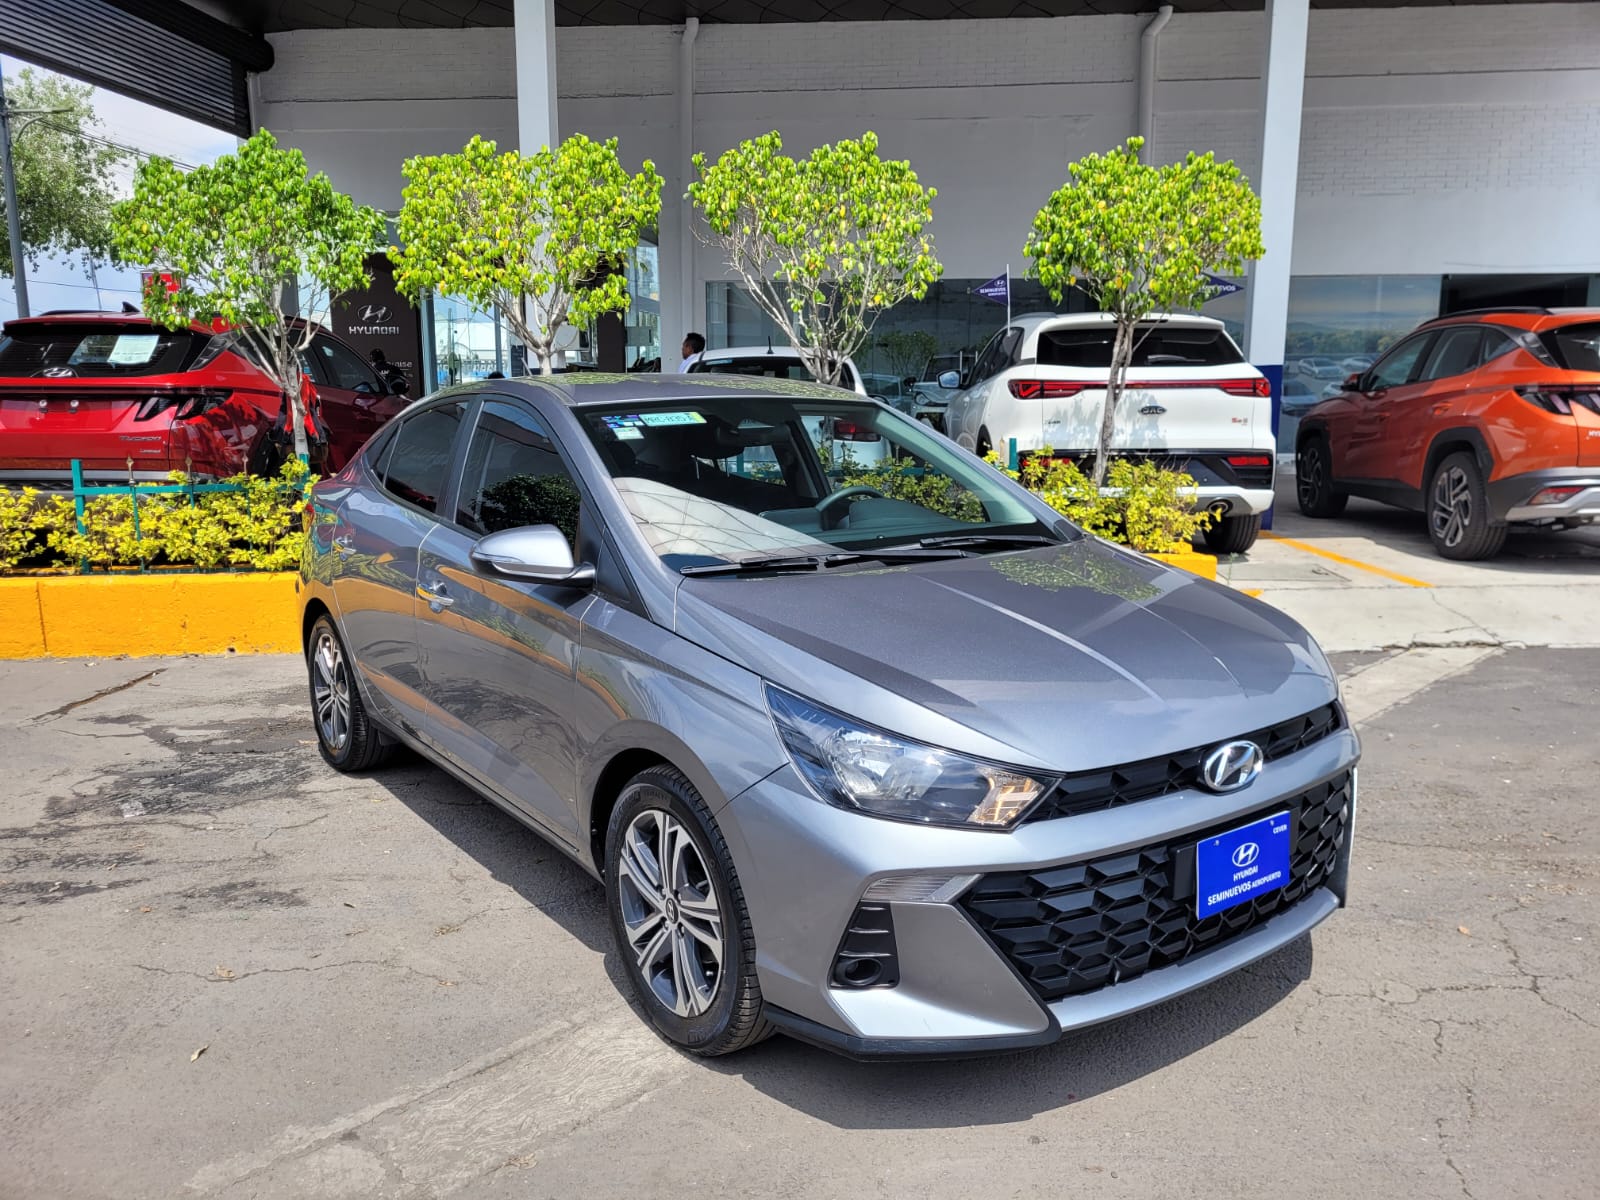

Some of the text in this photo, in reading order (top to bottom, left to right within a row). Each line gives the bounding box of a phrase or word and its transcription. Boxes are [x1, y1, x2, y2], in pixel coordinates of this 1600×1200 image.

[348, 326, 400, 335] HYUNDAI
[1141, 406, 1164, 415] JAC
[1272, 824, 1288, 834] CEVER
[1233, 865, 1259, 882] HYUNDAI
[1207, 870, 1282, 906] SEMINUEVOS AEROPUERTO
